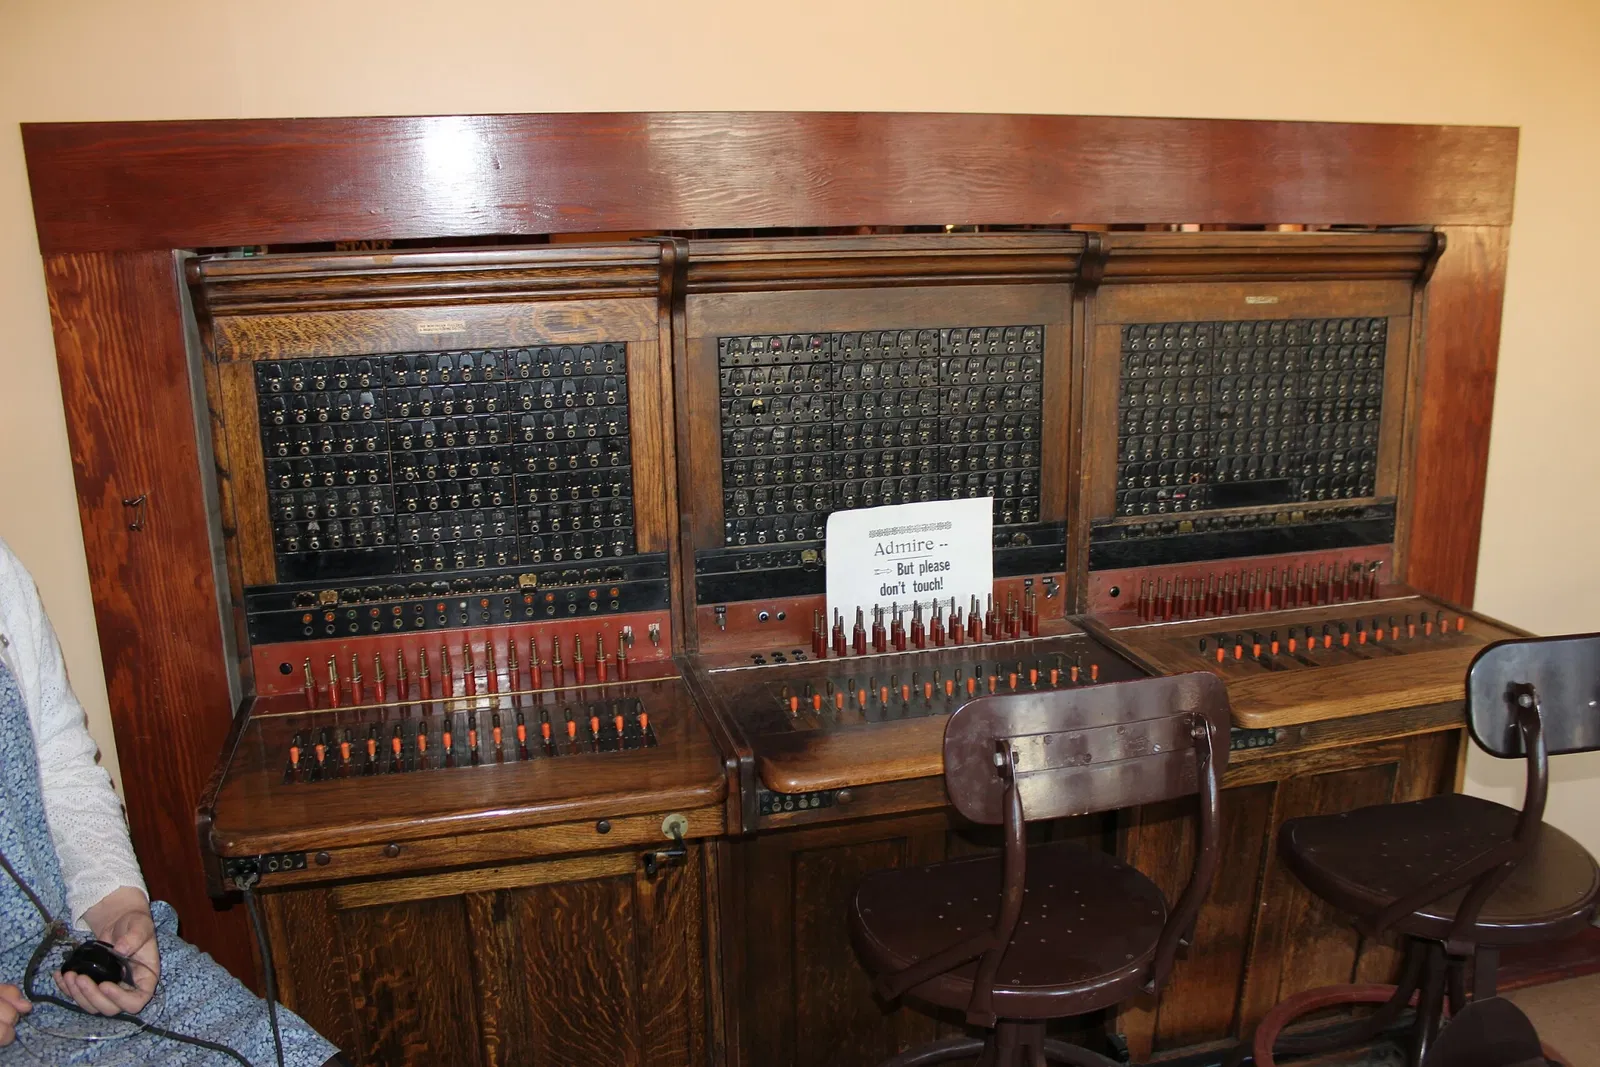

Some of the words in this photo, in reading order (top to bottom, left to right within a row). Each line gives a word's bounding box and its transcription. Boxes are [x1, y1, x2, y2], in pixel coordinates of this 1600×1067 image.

[874, 539, 935, 557] Admire
[897, 562, 915, 577] But
[919, 560, 951, 577] please
[880, 581, 906, 596] don't
[912, 576, 944, 593] touch!
